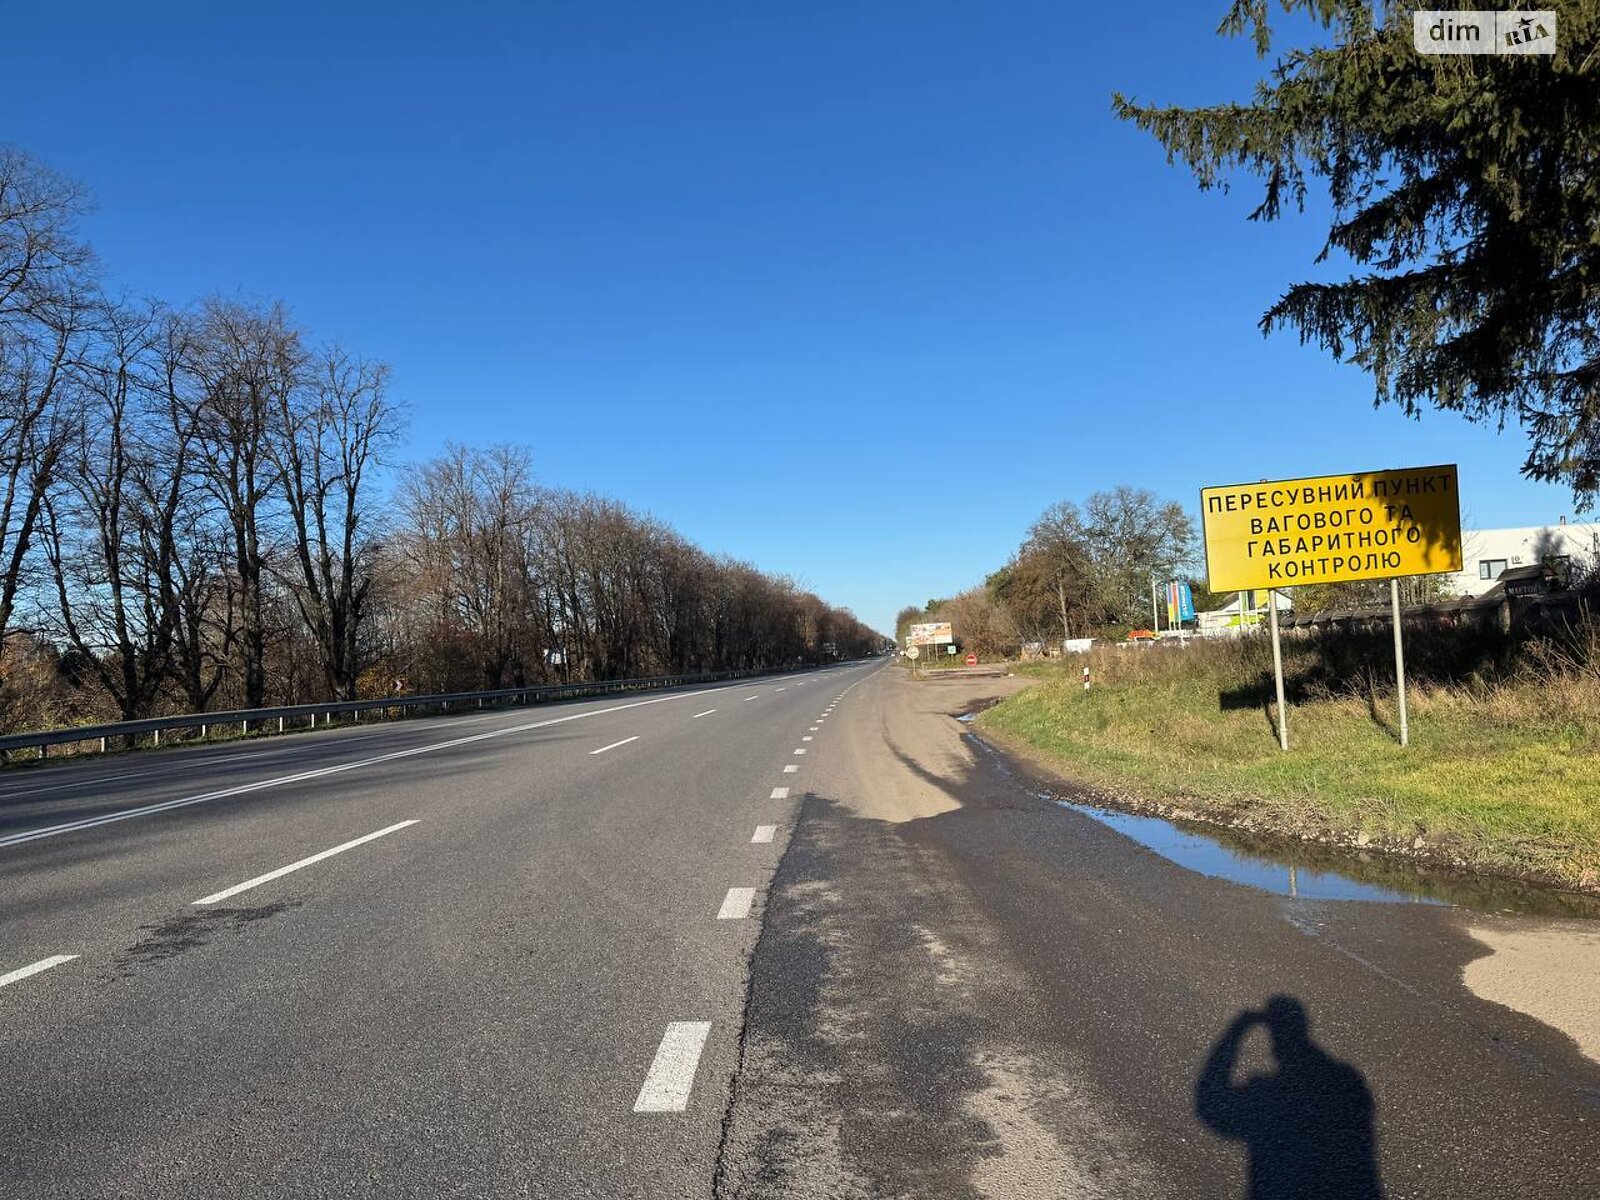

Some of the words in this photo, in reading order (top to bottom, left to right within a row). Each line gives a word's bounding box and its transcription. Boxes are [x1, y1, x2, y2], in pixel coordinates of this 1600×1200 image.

[1208, 479, 1364, 513] ПЕРЕСУВНИЙ
[1373, 474, 1451, 497] ПУНКТ
[1250, 507, 1373, 535] ВАГОВОГО
[1386, 504, 1415, 522] ТА
[1248, 526, 1421, 558] ГАБАРИТНОГО
[1268, 551, 1401, 579] КОНТРОЛЮ
